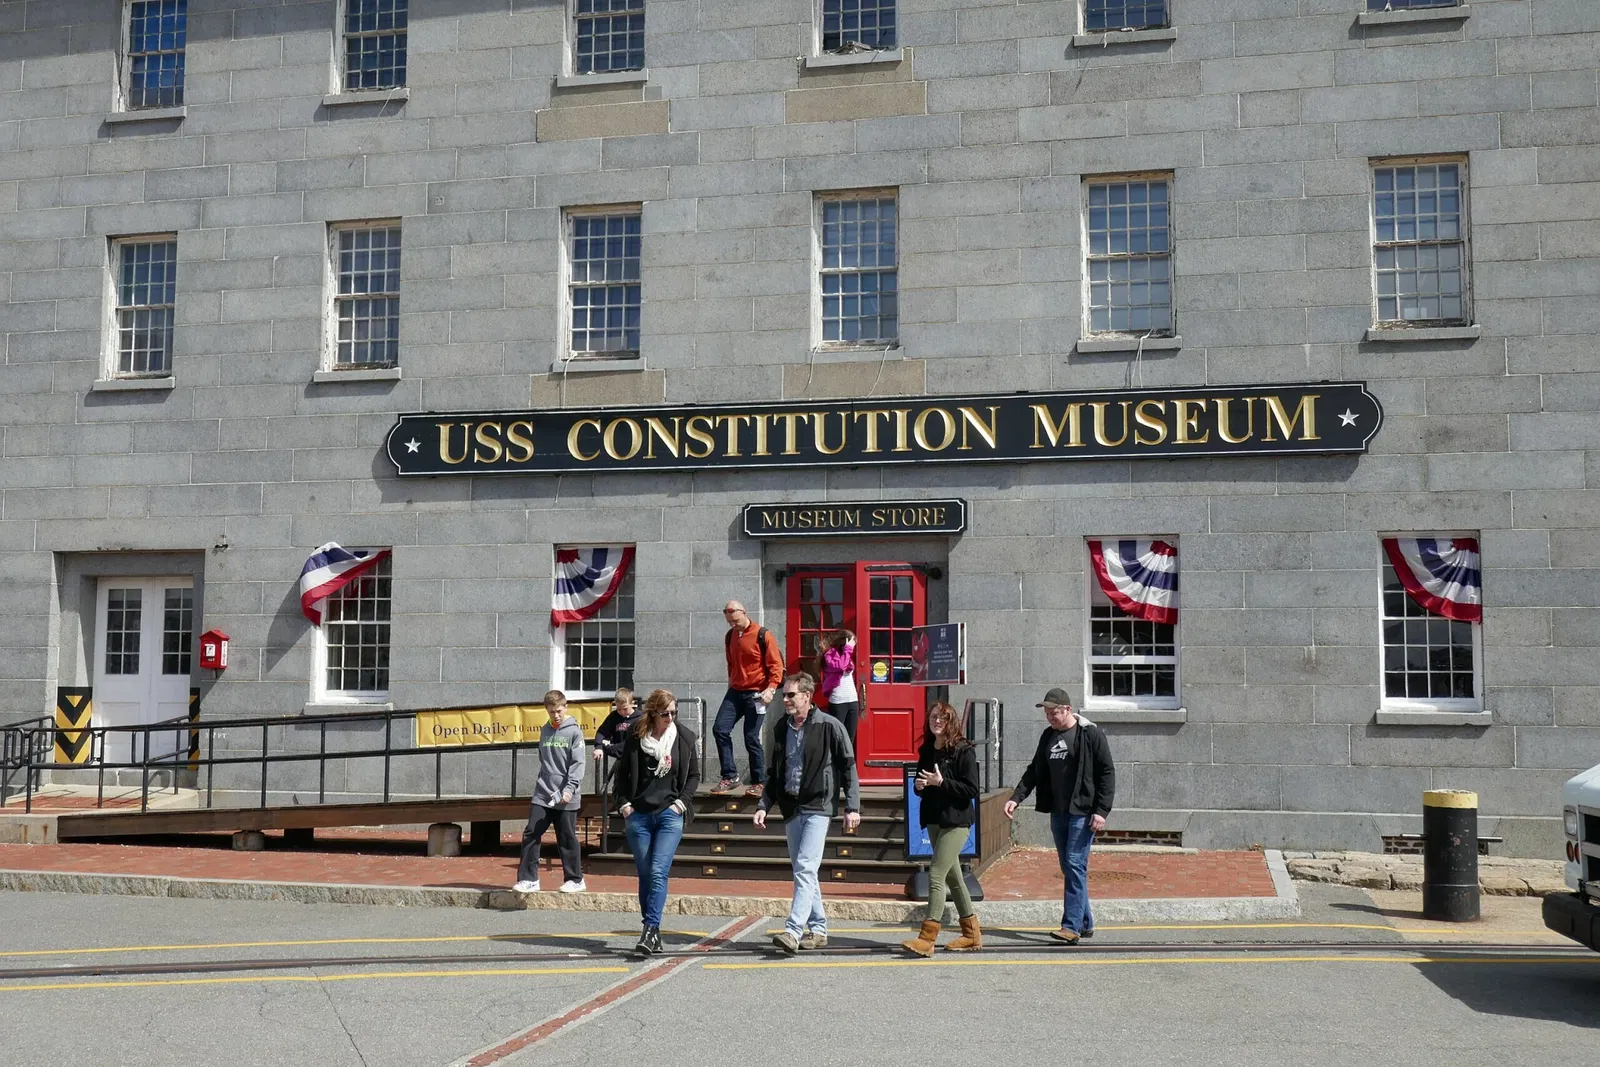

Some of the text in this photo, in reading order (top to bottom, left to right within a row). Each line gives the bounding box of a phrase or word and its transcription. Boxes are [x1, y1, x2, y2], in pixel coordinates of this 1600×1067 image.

[437, 395, 1320, 464] USS CONSTITUTION MUSEUM
[761, 507, 946, 529] MUSEUM STORE
[432, 724, 469, 738] Open
[473, 722, 509, 736] Daily
[514, 724, 524, 733] 10
